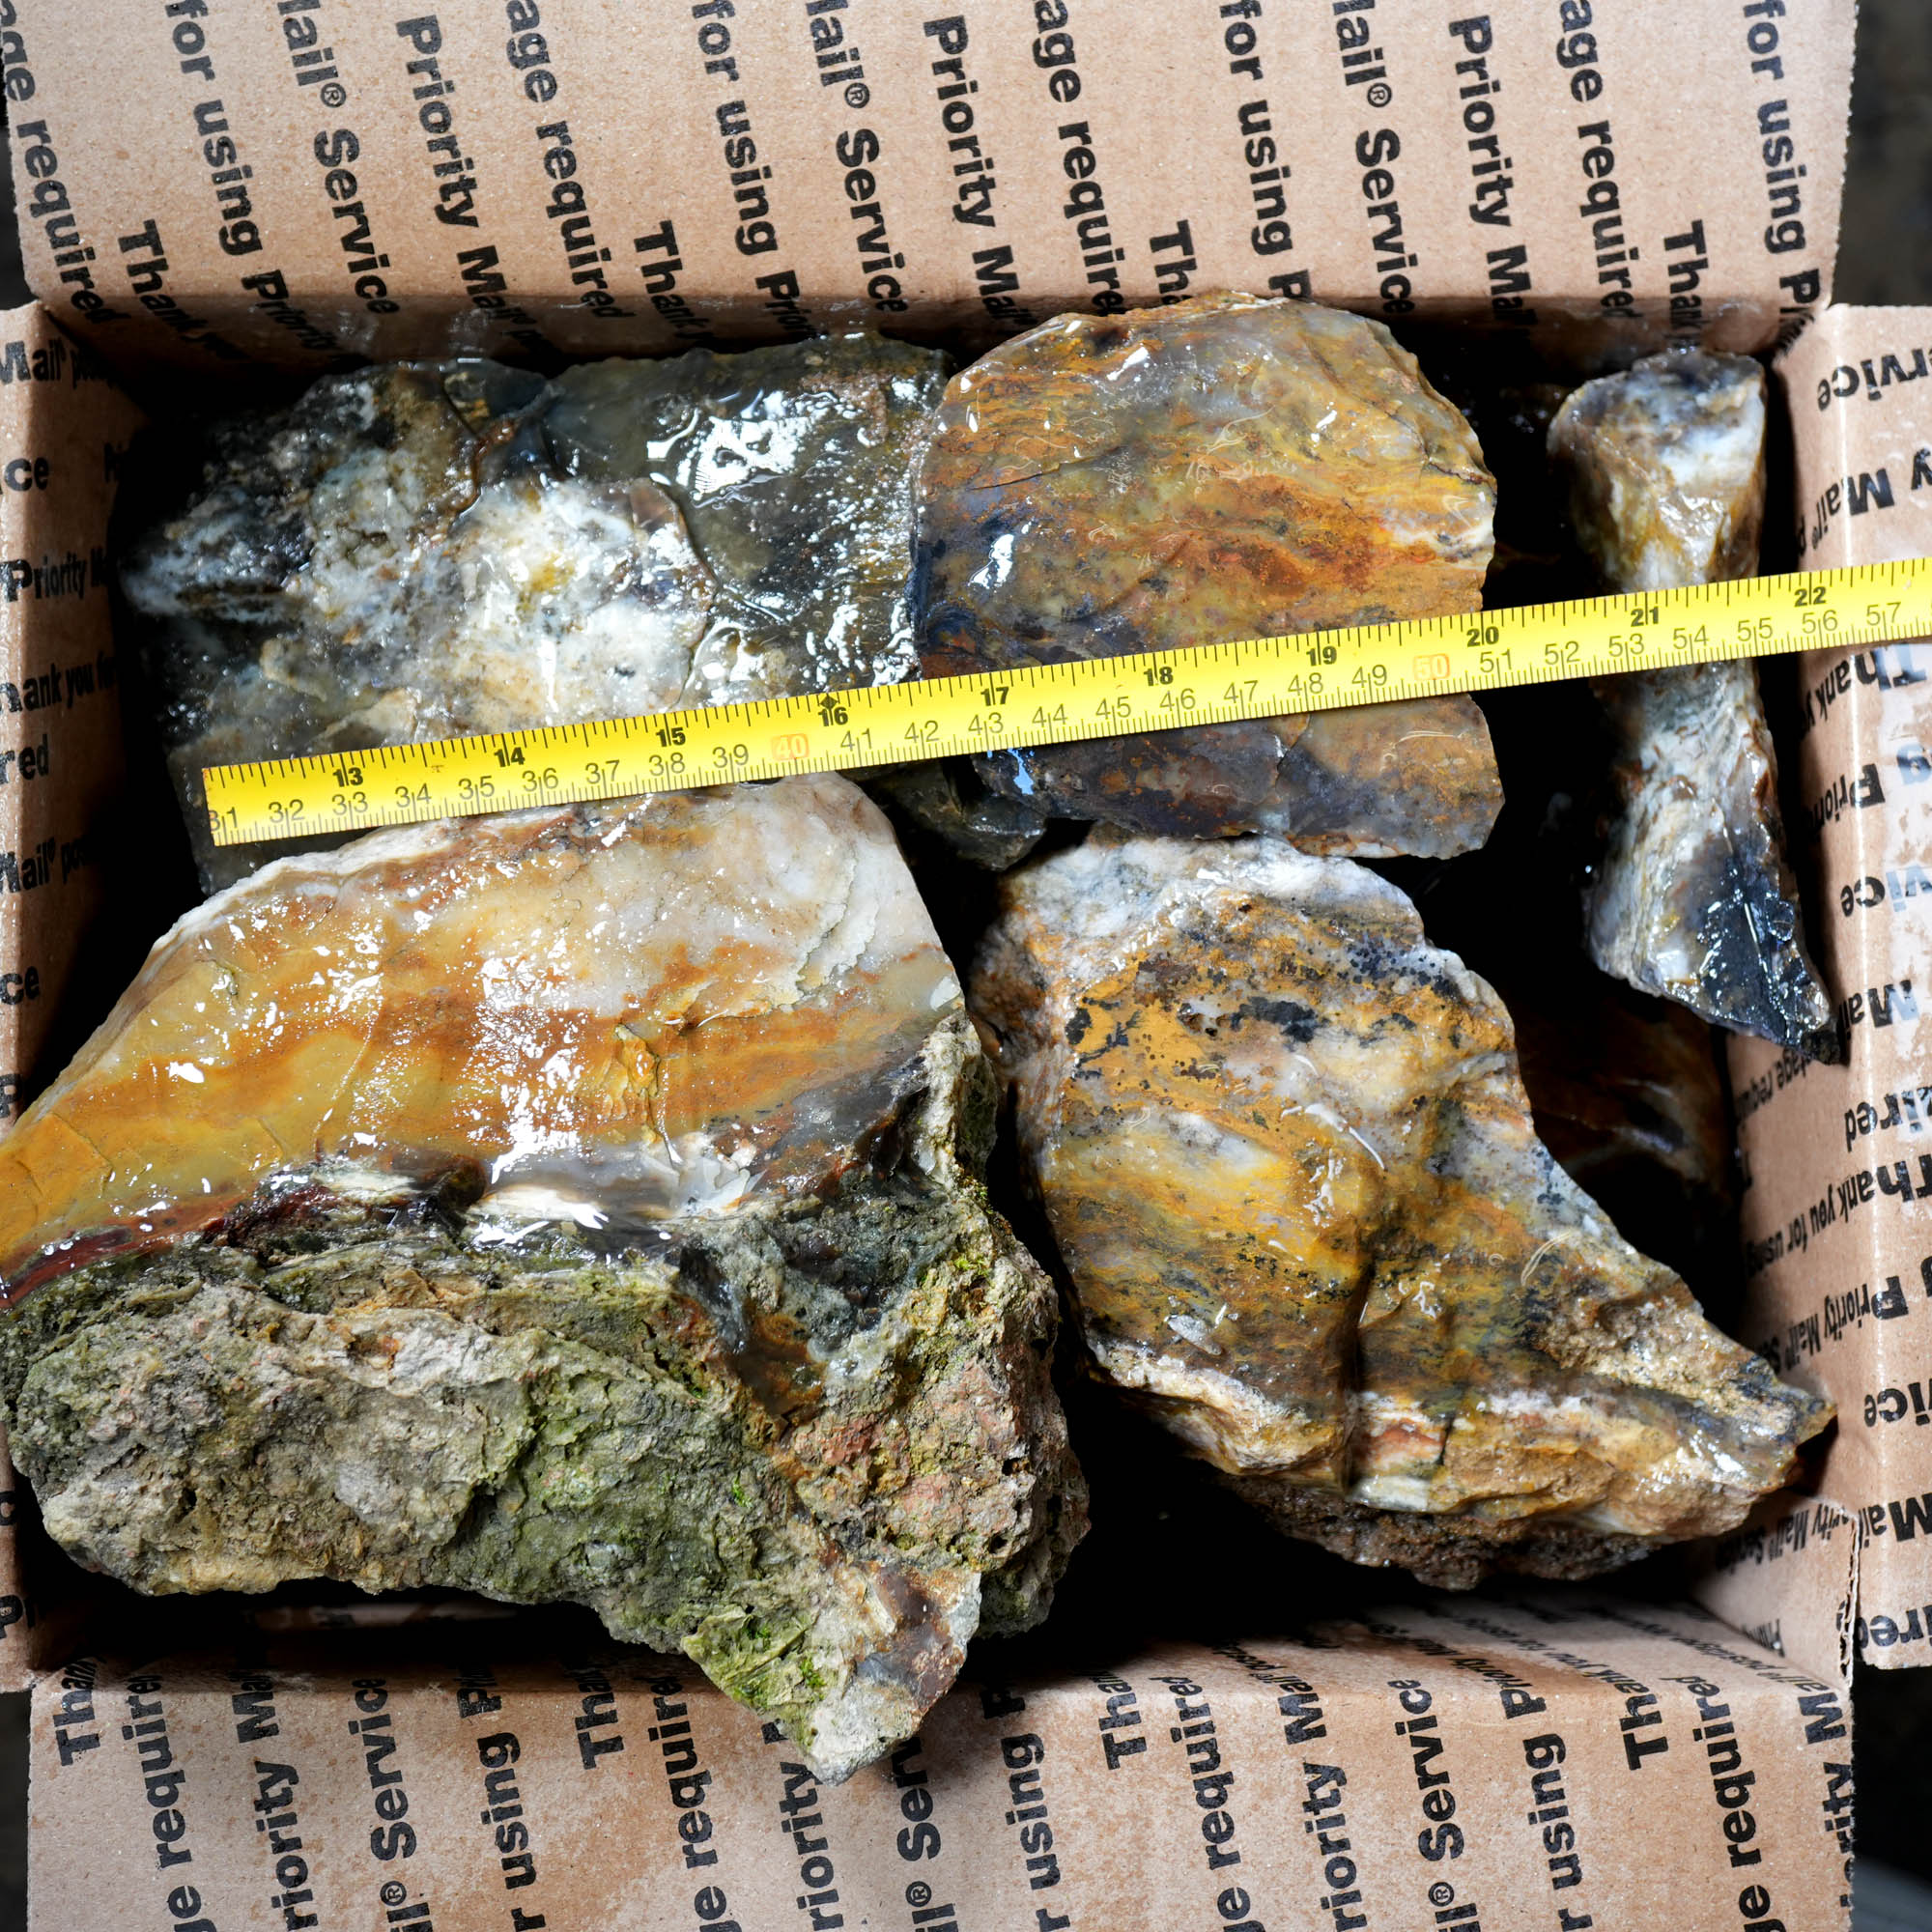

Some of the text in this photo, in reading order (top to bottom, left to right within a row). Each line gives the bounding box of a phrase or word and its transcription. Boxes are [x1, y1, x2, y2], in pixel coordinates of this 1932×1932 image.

[395, 14, 479, 228] Priority
[923, 14, 996, 228] Priority
[1220, 0, 1264, 81] for
[1449, 14, 1514, 228] Priority
[1743, 0, 1786, 80] for
[165, 0, 215, 81] for
[193, 99, 263, 255] using
[692, 0, 740, 82] for
[716, 99, 779, 256] using
[1237, 99, 1293, 255] using
[1756, 99, 1806, 253] using
[15, 120, 131, 324] required
[314, 128, 400, 313] Service
[535, 121, 637, 317] required
[836, 128, 908, 312] Service
[1058, 121, 1125, 317] require
[1354, 128, 1418, 313] Service
[1817, 348, 1932, 412] rvice
[1812, 469, 1894, 550] Mail®
[268, 799, 304, 824] 32
[331, 791, 368, 816] 33
[394, 782, 432, 809] 34
[458, 775, 496, 801] 35
[522, 767, 558, 792] 36
[584, 759, 620, 784] 37
[648, 752, 686, 777] 38
[712, 744, 750, 769] 39
[773, 734, 809, 760] 40
[839, 727, 872, 753] 41
[904, 720, 940, 745] 42
[967, 712, 1004, 736] 43
[1032, 704, 1068, 728] 44
[1095, 696, 1132, 721] 45
[1159, 688, 1196, 713] 46
[1223, 680, 1259, 705] 47
[1287, 672, 1324, 696] 48
[1351, 664, 1388, 689] 49
[1413, 654, 1450, 680] 50
[1479, 649, 1513, 673] 51
[1545, 640, 1580, 666] 52
[1608, 633, 1645, 658] 53
[1672, 624, 1710, 650] 54
[1737, 617, 1774, 642] 55
[1802, 610, 1838, 634] 56
[1866, 601, 1902, 626] 57
[333, 585, 1827, 787] 13 14 15 16 17 18 19 20 21 22
[1816, 643, 1927, 721] Thank
[1788, 1214, 1808, 1253] for
[1809, 1184, 1836, 1236] you
[1824, 1275, 1909, 1341] Priority
[1863, 1378, 1932, 1428] ice
[348, 1678, 416, 1861] Service
[1149, 1676, 1241, 1870] required
[1388, 1680, 1464, 1861] Service
[1449, 1658, 1547, 1719] Priority
[1581, 1669, 1669, 1771] Thank
[1659, 1676, 1762, 1869] required
[477, 1732, 537, 1890] using
[892, 1737, 941, 1862] Serv
[1001, 1733, 1061, 1890] using
[1523, 1733, 1582, 1890] using
